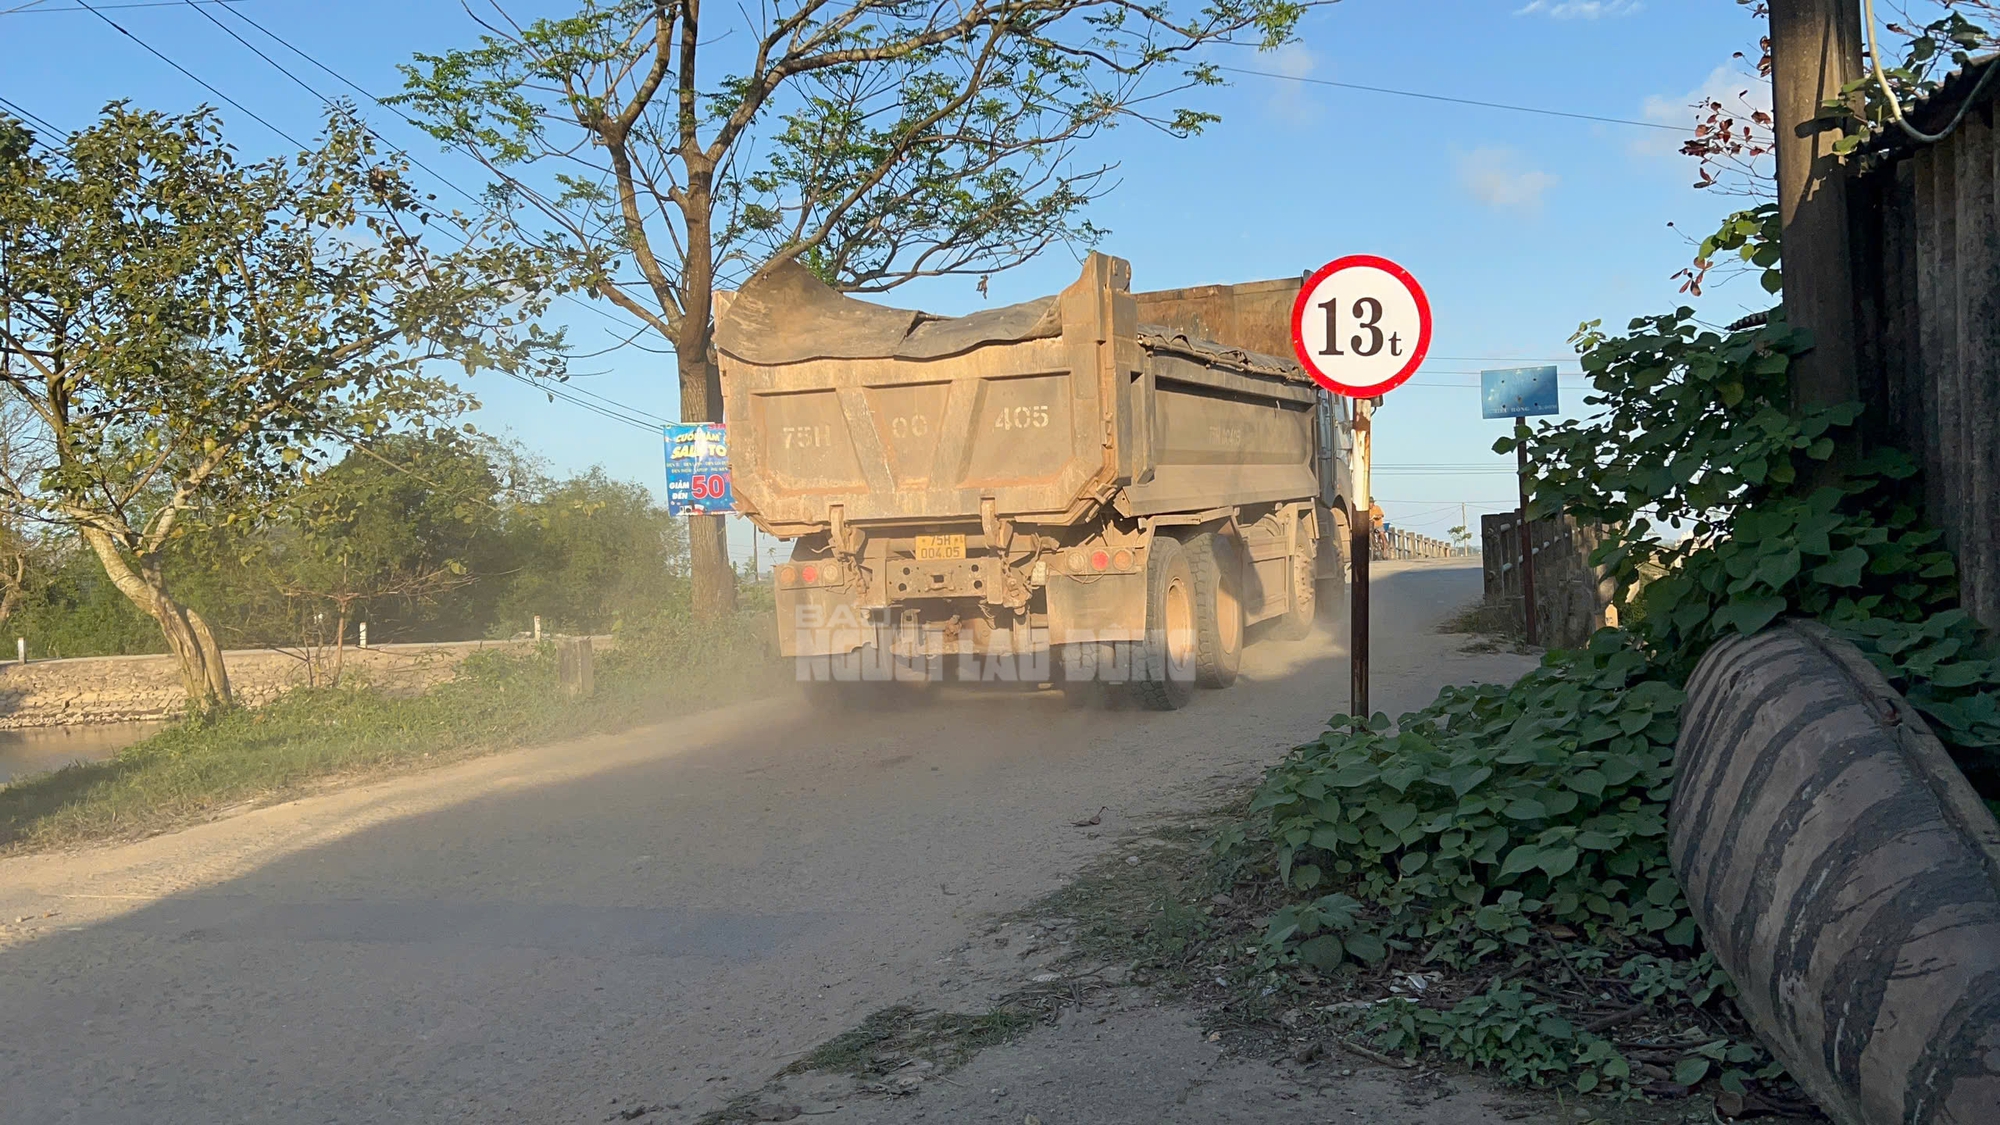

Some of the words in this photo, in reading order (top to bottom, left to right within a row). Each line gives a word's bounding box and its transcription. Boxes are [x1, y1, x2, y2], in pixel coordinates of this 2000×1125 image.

[892, 415, 928, 438] 00
[995, 405, 1049, 431] 405
[921, 547, 960, 558] 004.05
